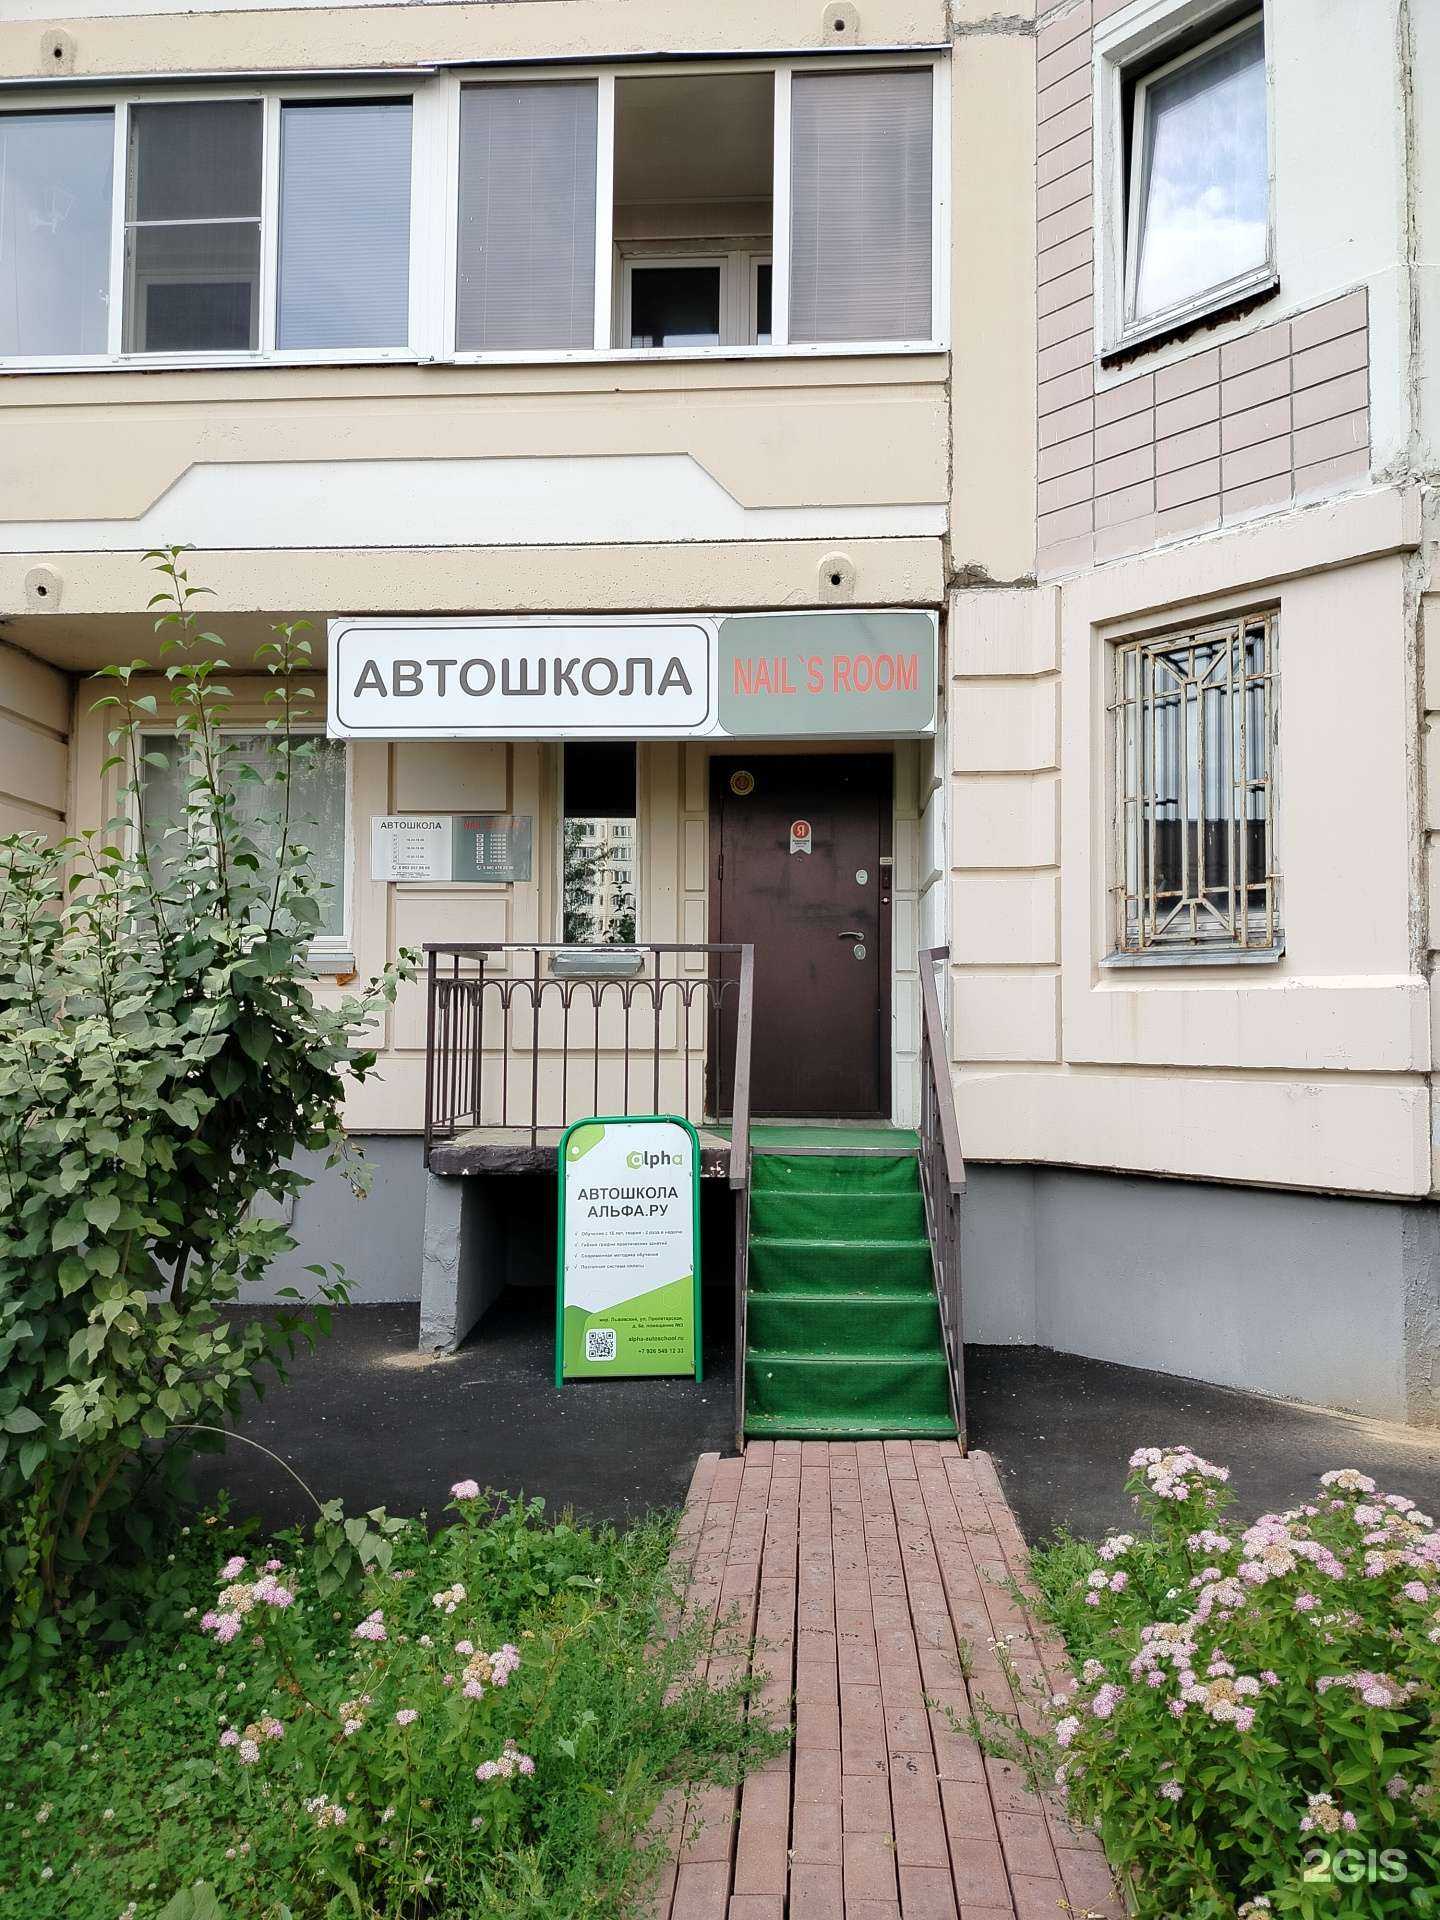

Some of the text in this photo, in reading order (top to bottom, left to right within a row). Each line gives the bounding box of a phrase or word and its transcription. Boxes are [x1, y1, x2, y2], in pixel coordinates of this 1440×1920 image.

[353, 656, 693, 698] АВТОШКОЛА
[833, 653, 919, 693] ROOM
[380, 821, 442, 830] АВТОШКОЛА
[626, 1150, 683, 1169] alpha
[578, 1186, 679, 1201] АВТОШКОЛА
[587, 1203, 669, 1218] АЛЬФА.РУ
